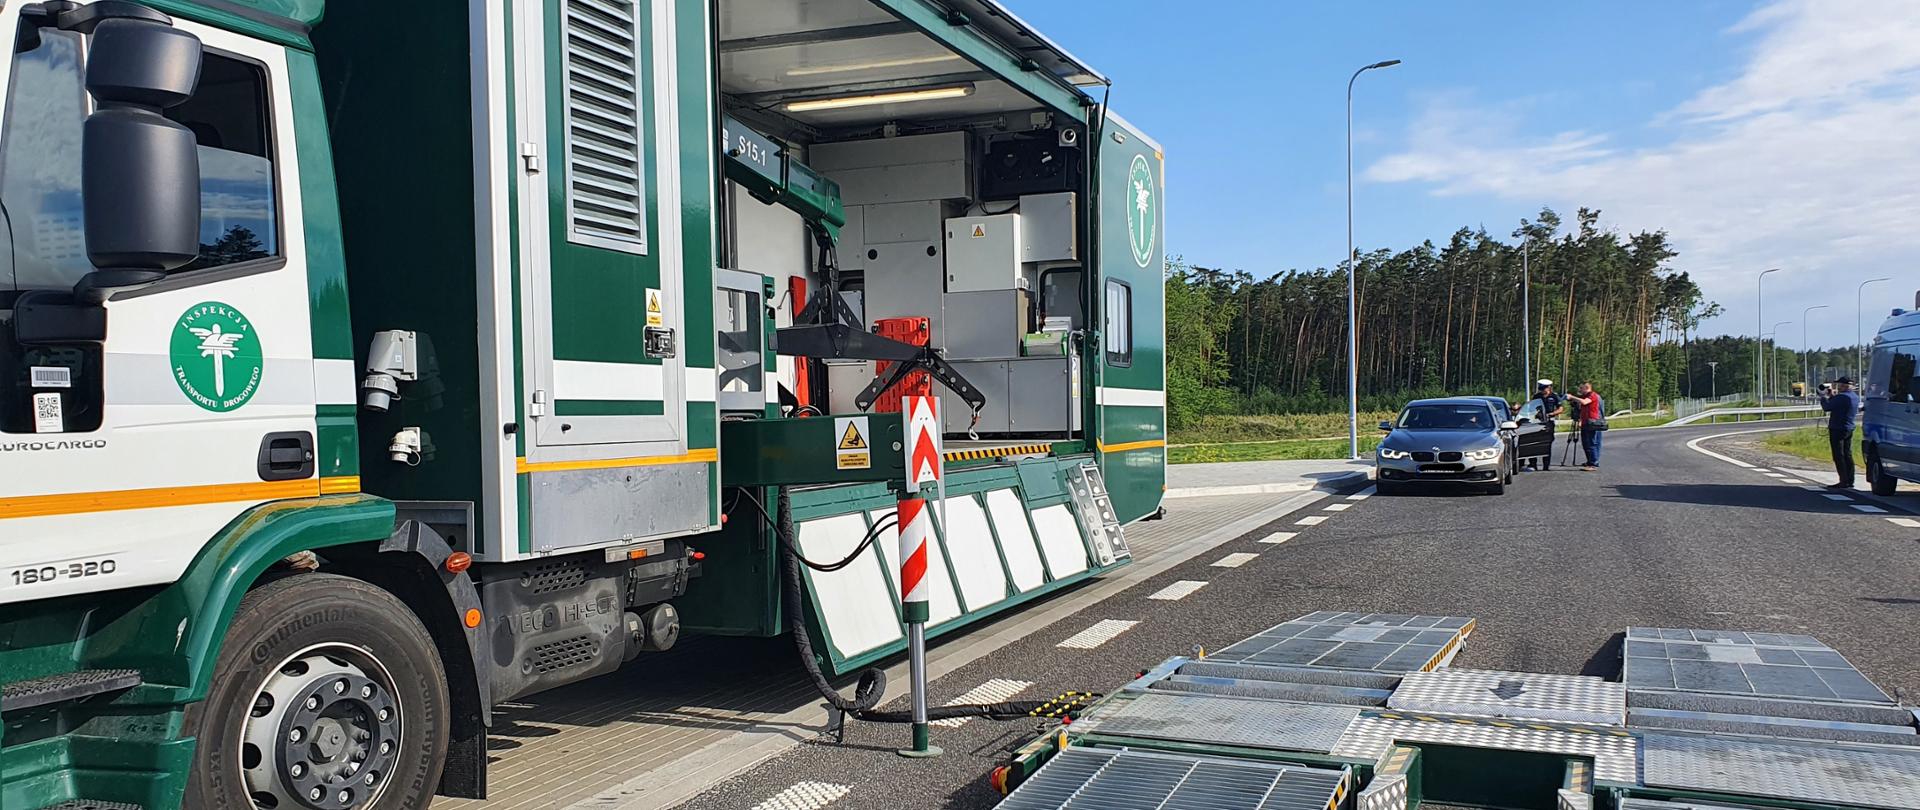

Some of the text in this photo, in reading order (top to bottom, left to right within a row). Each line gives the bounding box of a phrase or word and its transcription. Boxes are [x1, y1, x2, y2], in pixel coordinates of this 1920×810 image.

[739, 135, 766, 167] S15.1
[181, 305, 248, 332] INSPEKCJA
[176, 365, 260, 408] TRANSPORTU DROGOWEGO
[0, 439, 107, 452] UROCARGO
[11, 559, 116, 585] 180-320
